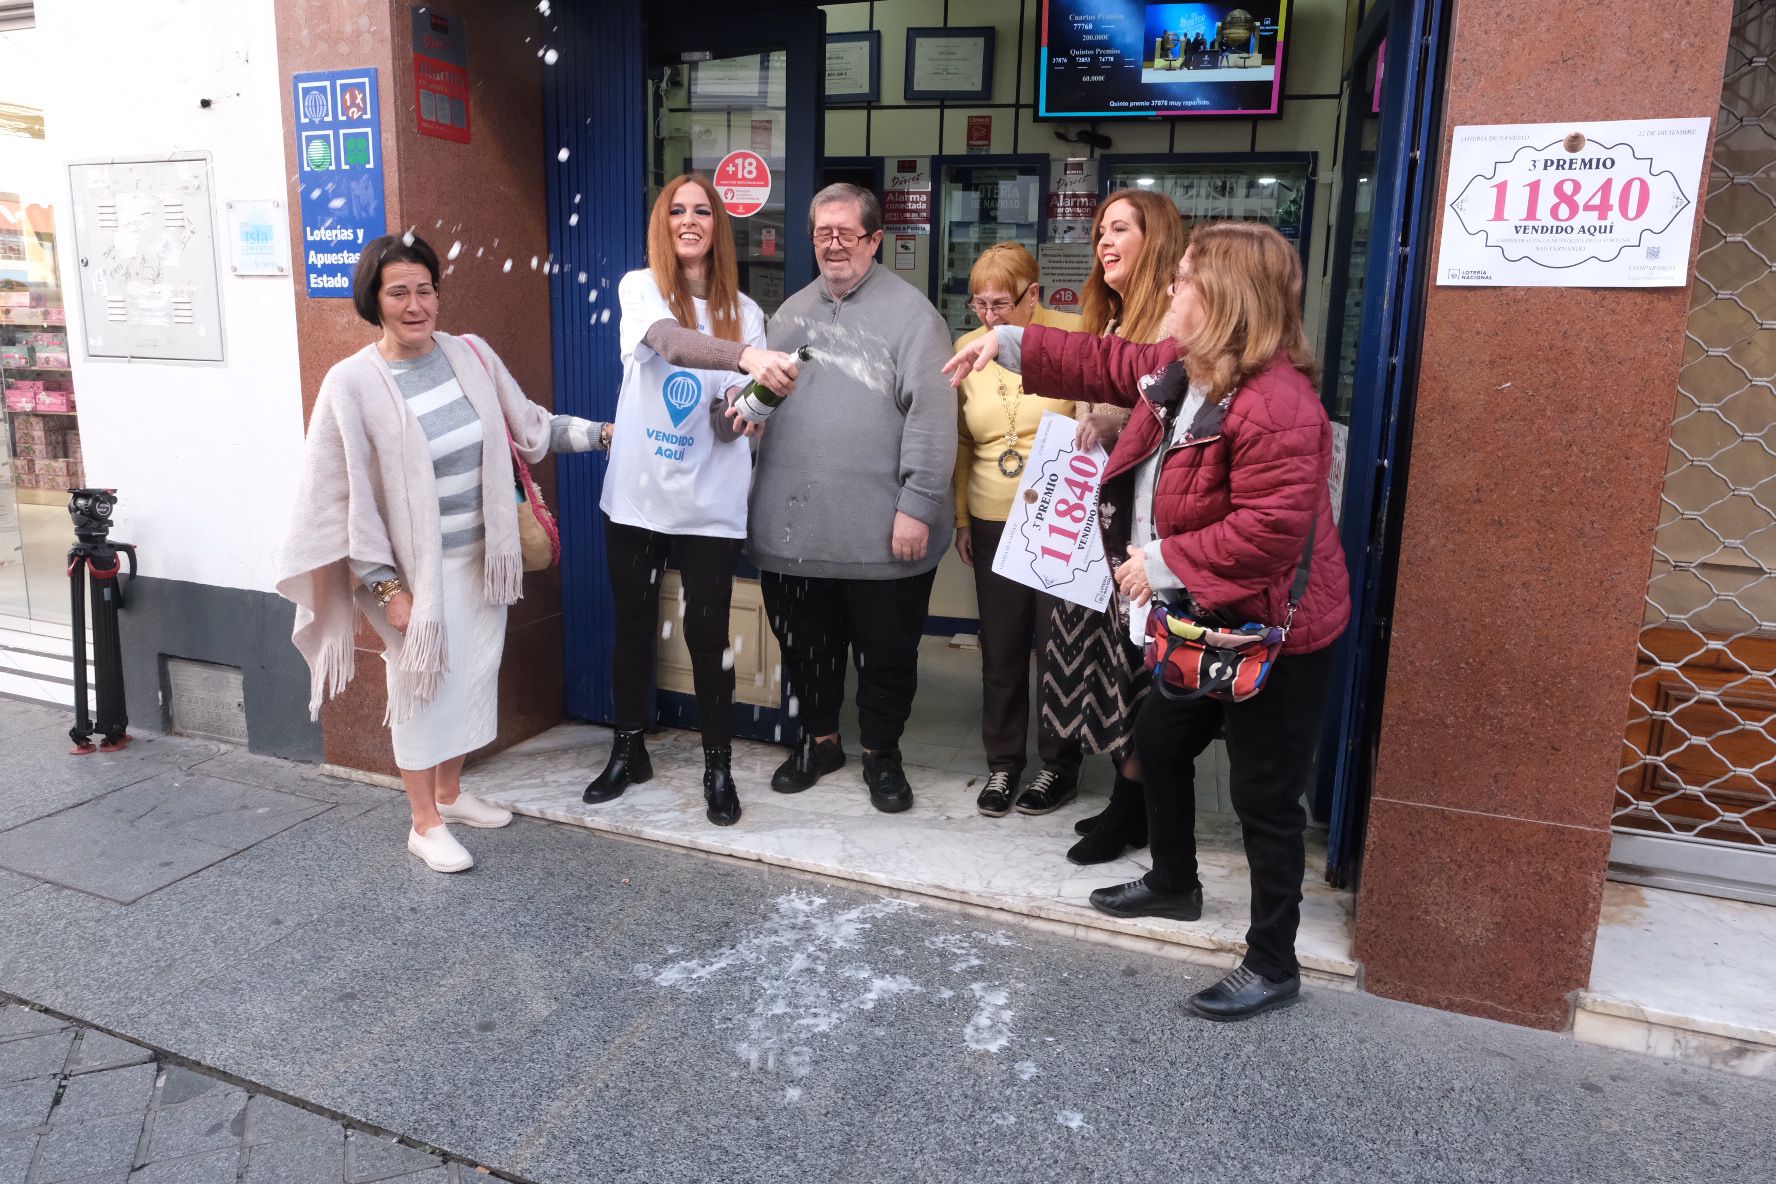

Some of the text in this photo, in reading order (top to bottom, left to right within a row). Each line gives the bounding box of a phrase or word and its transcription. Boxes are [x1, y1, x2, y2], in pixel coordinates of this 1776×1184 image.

[1070, 48, 1094, 56] Quintos
[726, 158, 757, 178] +18
[1542, 158, 1616, 171] PREMIO
[887, 193, 927, 202] Alarma
[984, 200, 1020, 208] NAVIDAD
[1050, 195, 1096, 206] Alarma
[1486, 177, 1650, 222] 11840
[306, 225, 364, 244] Loterías y
[1514, 222, 1614, 236] VENDIDO AQUÍ
[308, 250, 360, 268] Apuestas
[310, 273, 349, 288] Estado
[1056, 290, 1073, 301] +18
[646, 428, 694, 447] VENDIDO
[654, 446, 685, 462] AQUÍ
[1036, 472, 1059, 521] PREMIO
[1040, 454, 1099, 567] 11840
[1078, 509, 1098, 550] VENDIDO
